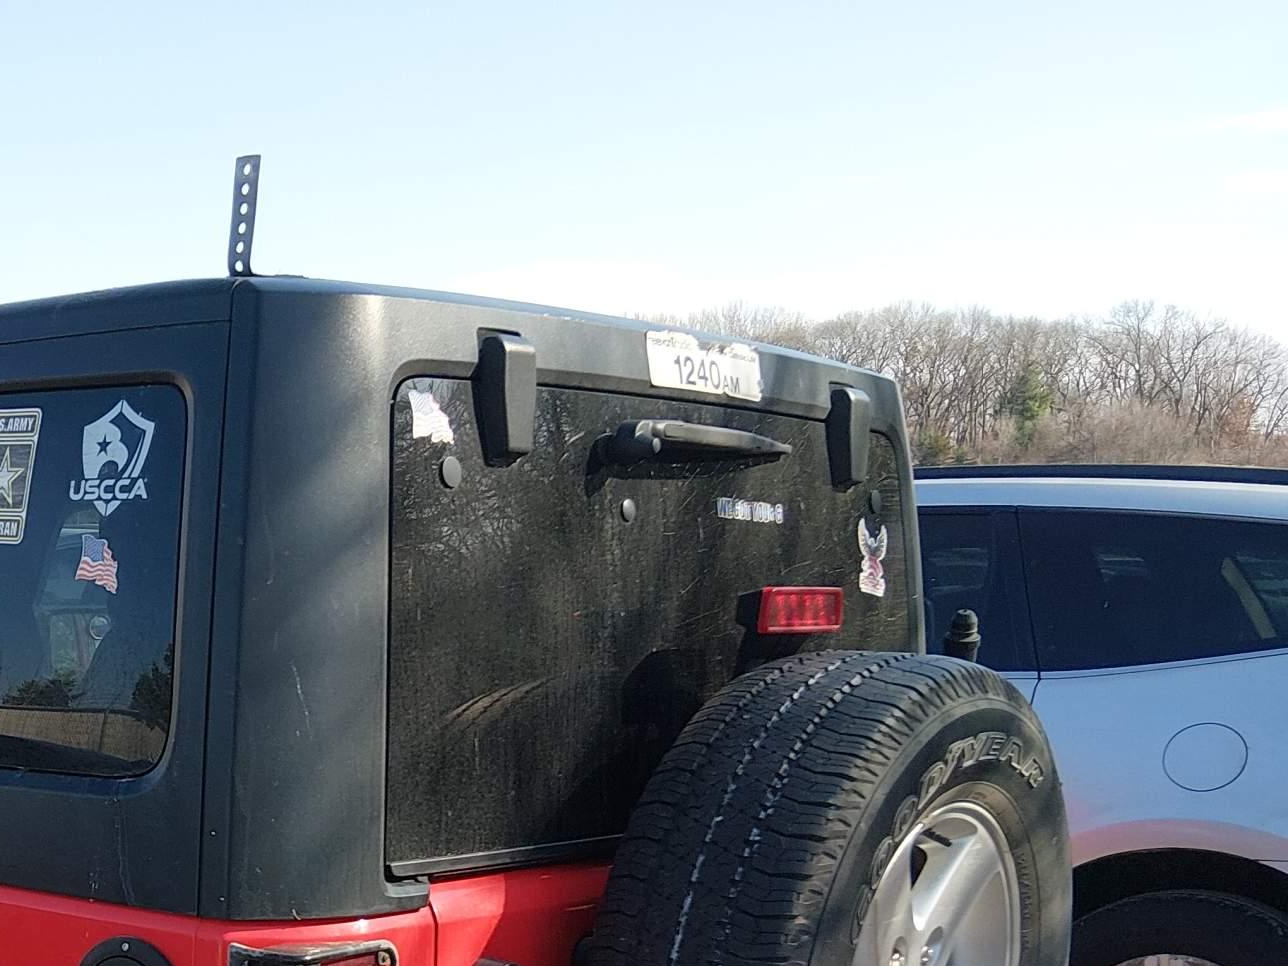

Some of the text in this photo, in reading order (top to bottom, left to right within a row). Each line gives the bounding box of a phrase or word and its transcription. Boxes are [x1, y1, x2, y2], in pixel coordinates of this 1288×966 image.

[674, 355, 721, 389] 1240
[723, 375, 741, 393] AM
[69, 478, 148, 501] USCCA
